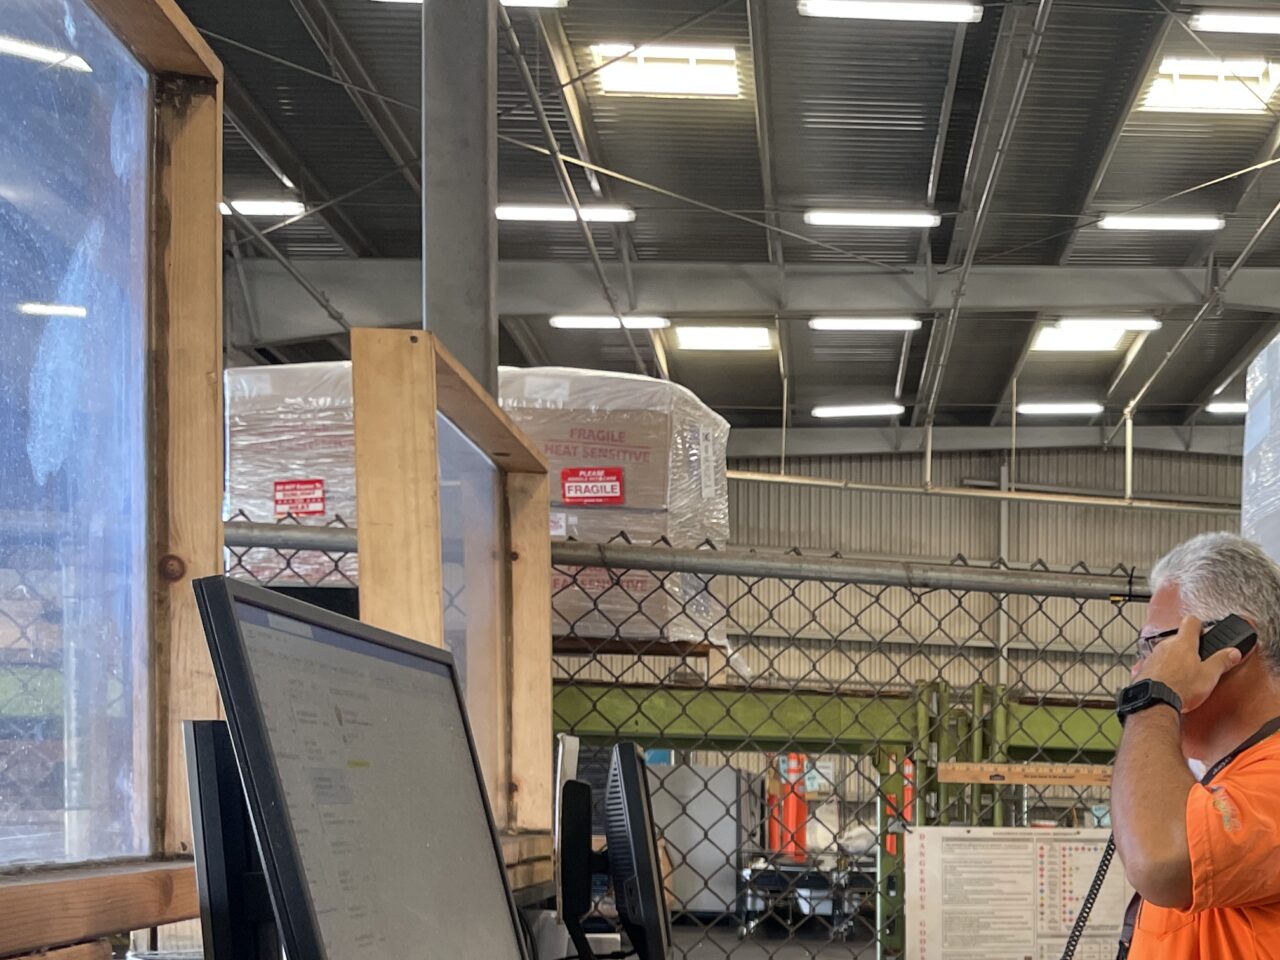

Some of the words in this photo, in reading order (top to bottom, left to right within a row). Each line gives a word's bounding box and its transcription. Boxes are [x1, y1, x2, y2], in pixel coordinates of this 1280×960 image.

[570, 428, 626, 442] FRAGILE
[544, 444, 578, 458] HEAT
[582, 446, 650, 462] SENSITIVE
[567, 483, 619, 495] FRAGILE
